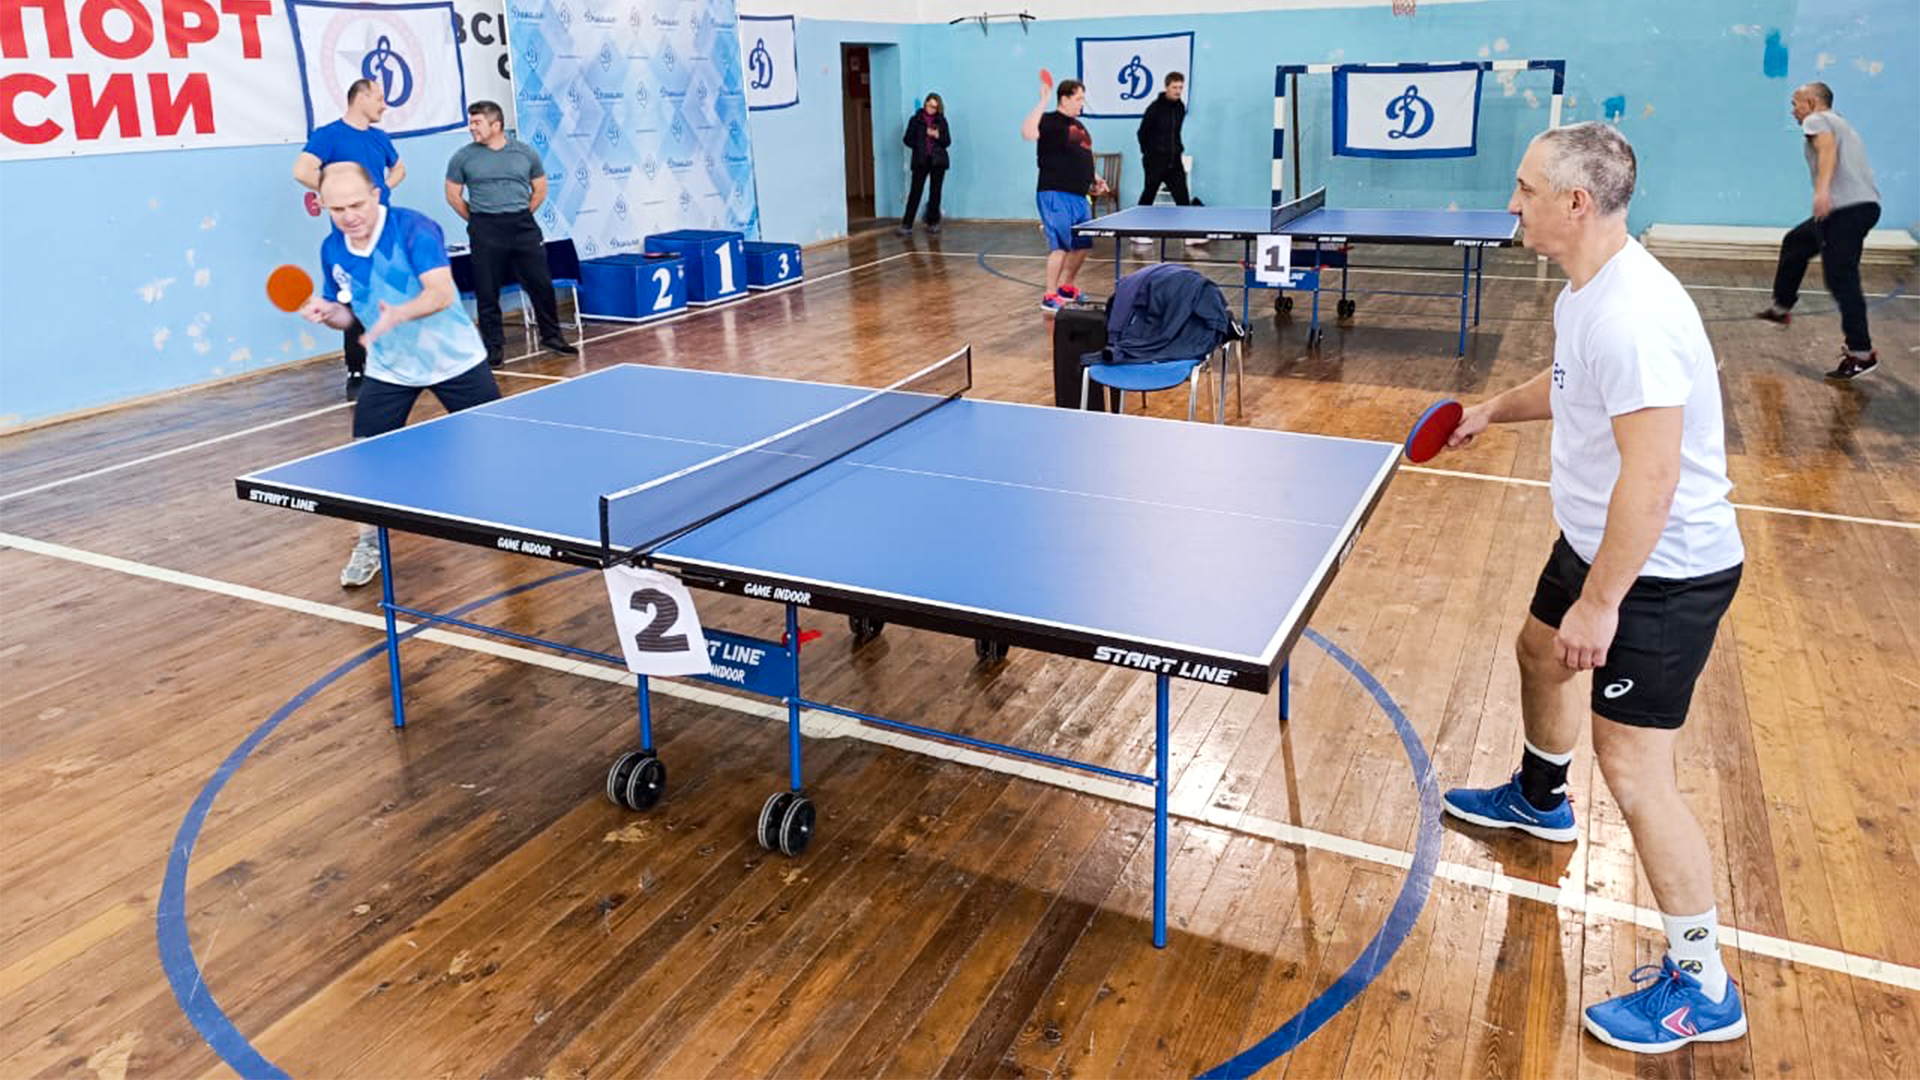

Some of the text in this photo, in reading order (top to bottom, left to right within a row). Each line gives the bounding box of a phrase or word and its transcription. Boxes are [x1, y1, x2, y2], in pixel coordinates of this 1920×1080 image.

[0, 0, 271, 60] ПОРТ
[0, 72, 215, 145] СИИ
[714, 241, 737, 294] 1
[777, 253, 790, 279] 3
[1264, 245, 1284, 272] 1
[652, 268, 673, 310] 2
[249, 489, 318, 512] START LINE
[497, 536, 552, 558] GAME INDOOR
[743, 582, 811, 606] GAME INDOOR
[630, 588, 690, 651] 2
[722, 643, 765, 666] LINE
[1093, 645, 1238, 685] START LINE
